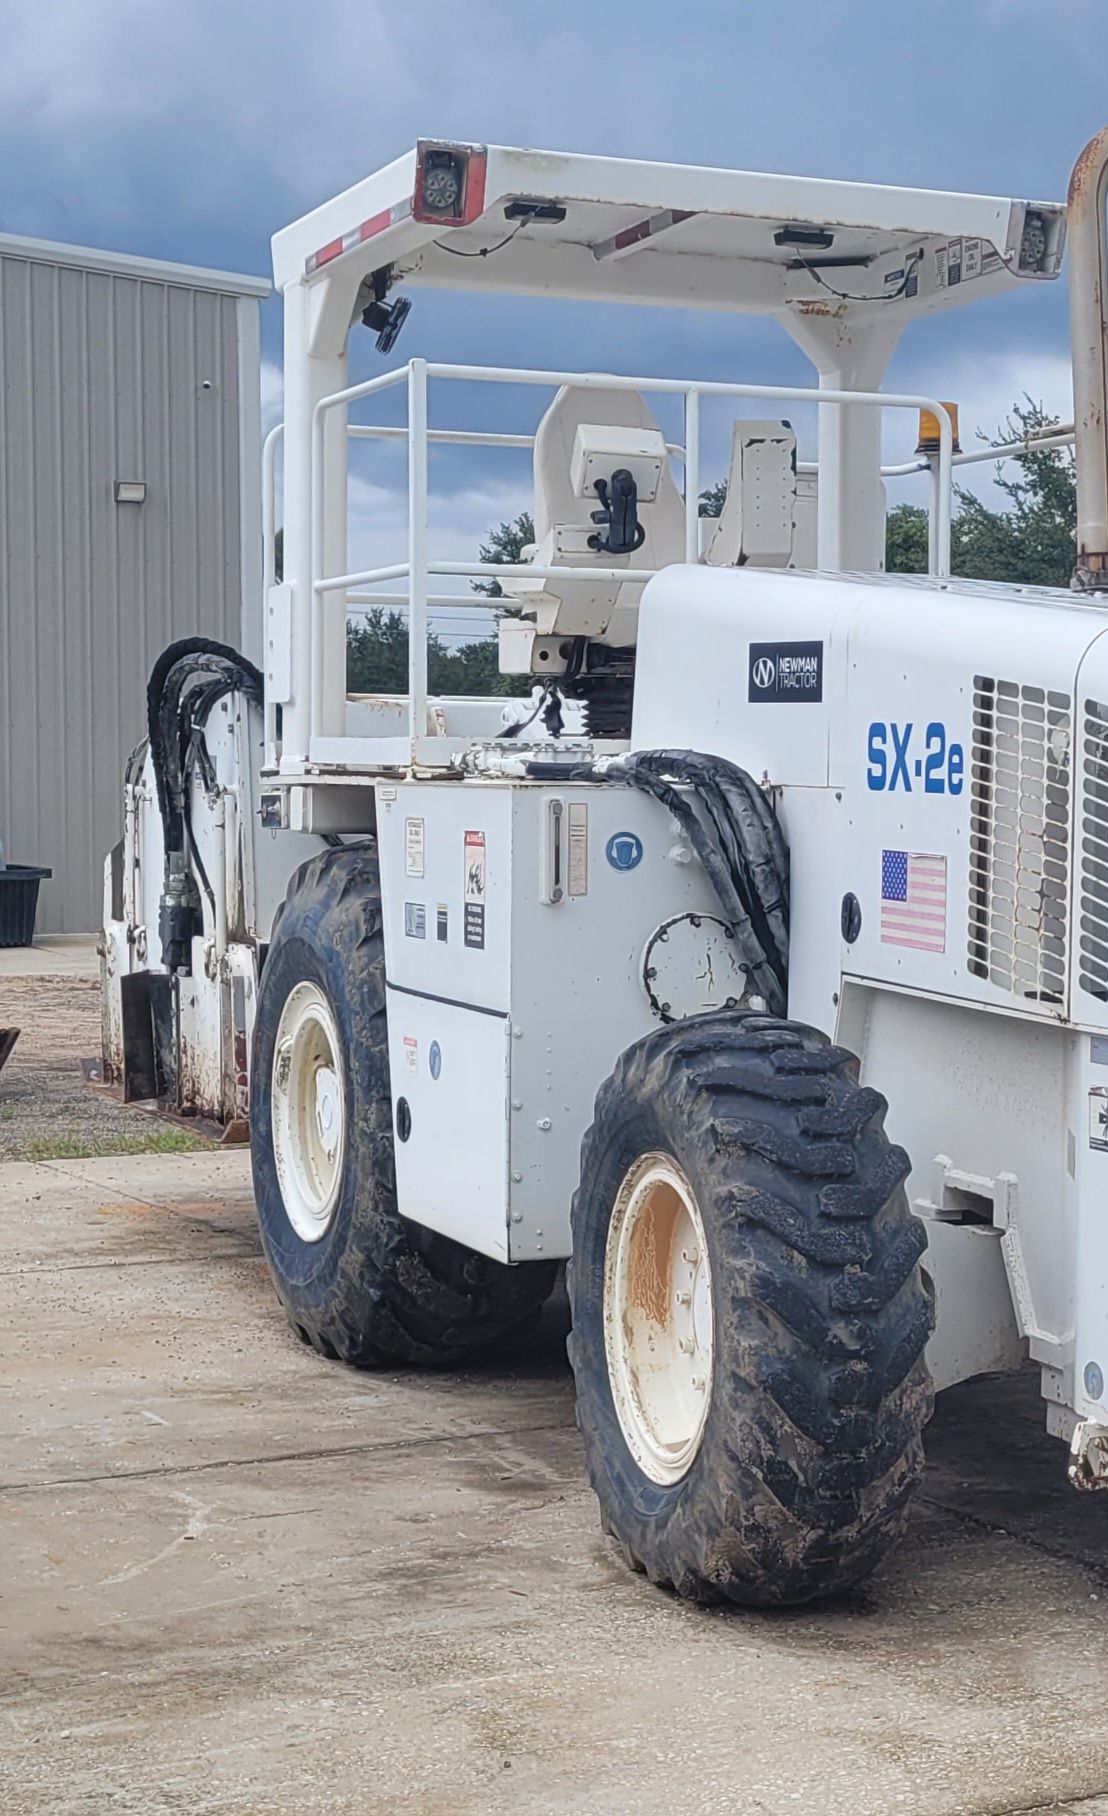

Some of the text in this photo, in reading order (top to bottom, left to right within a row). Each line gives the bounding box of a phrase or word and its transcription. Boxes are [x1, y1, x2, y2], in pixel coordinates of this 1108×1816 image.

[779, 656, 818, 672] NEWMAN
[779, 672, 817, 688] TRACTOR
[867, 722, 964, 795] SX-2e
